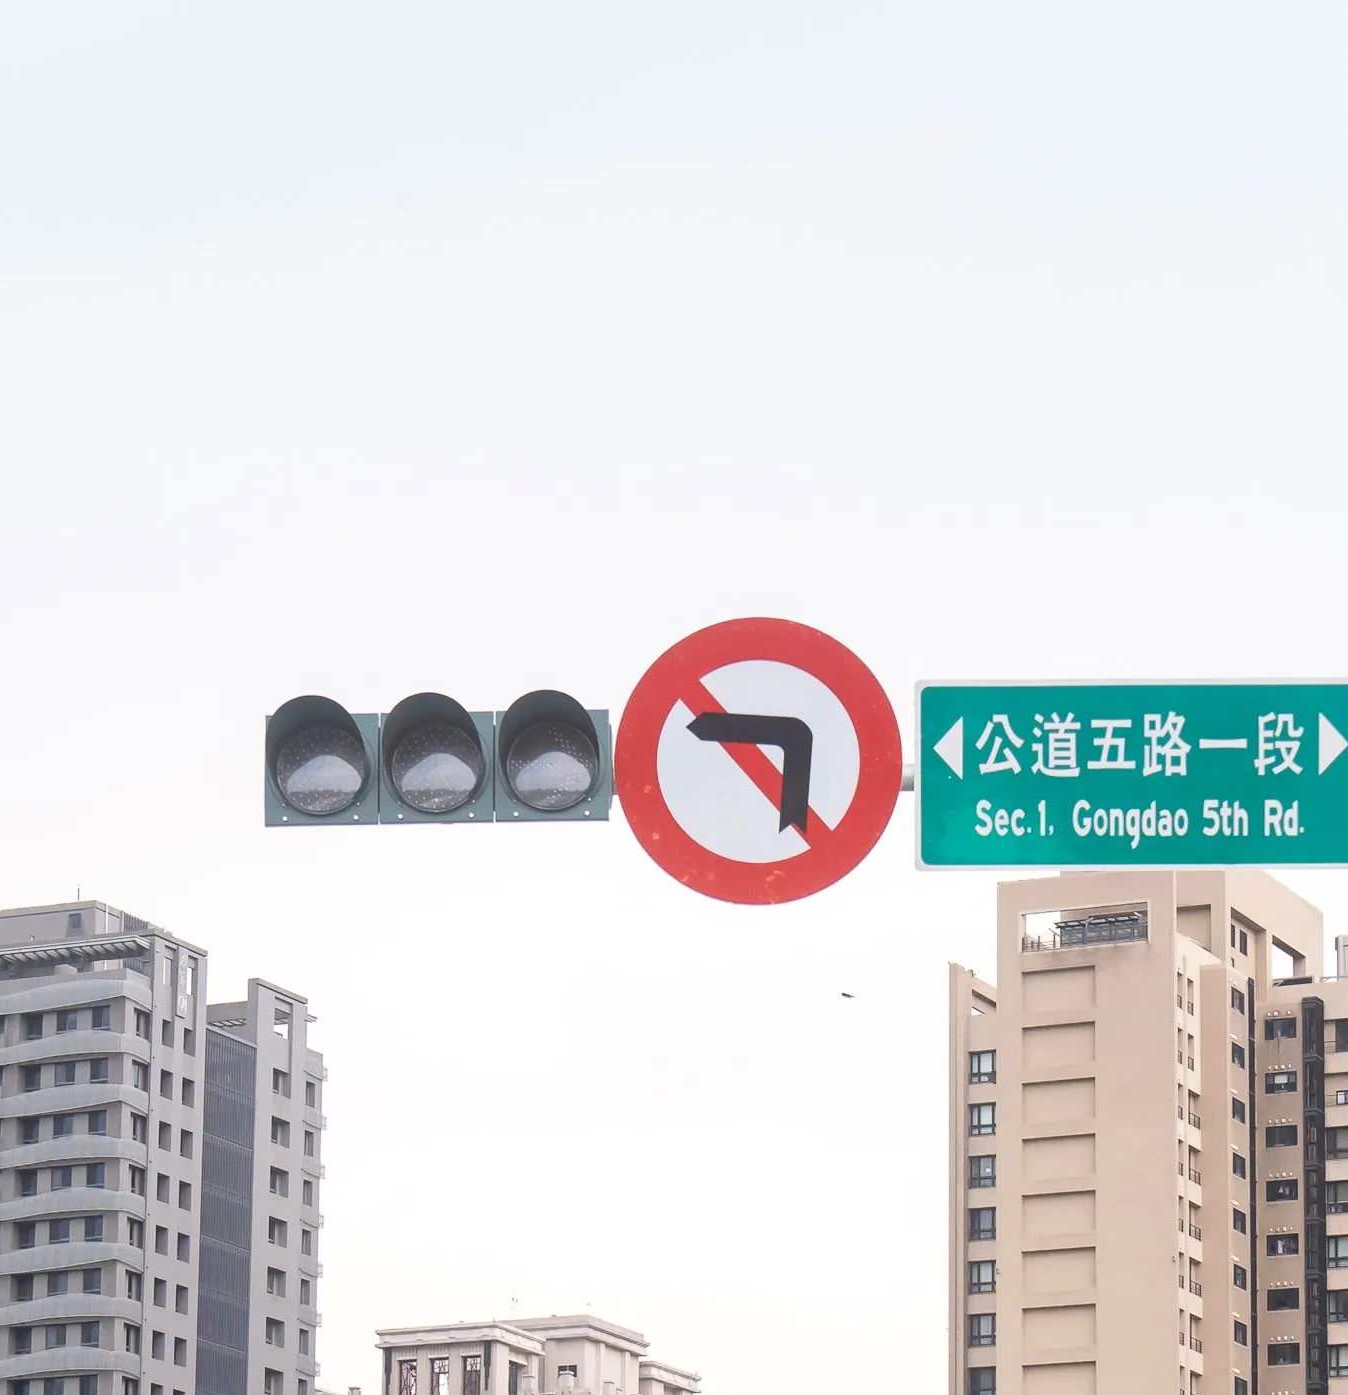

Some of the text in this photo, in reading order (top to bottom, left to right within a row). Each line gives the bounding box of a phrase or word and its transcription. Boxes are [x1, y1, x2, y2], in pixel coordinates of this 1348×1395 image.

[974, 710, 1305, 778] 公道五路一段
[1072, 799, 1189, 850] Gongdao
[1202, 799, 1249, 837] 5th
[1264, 799, 1305, 837] Rd.
